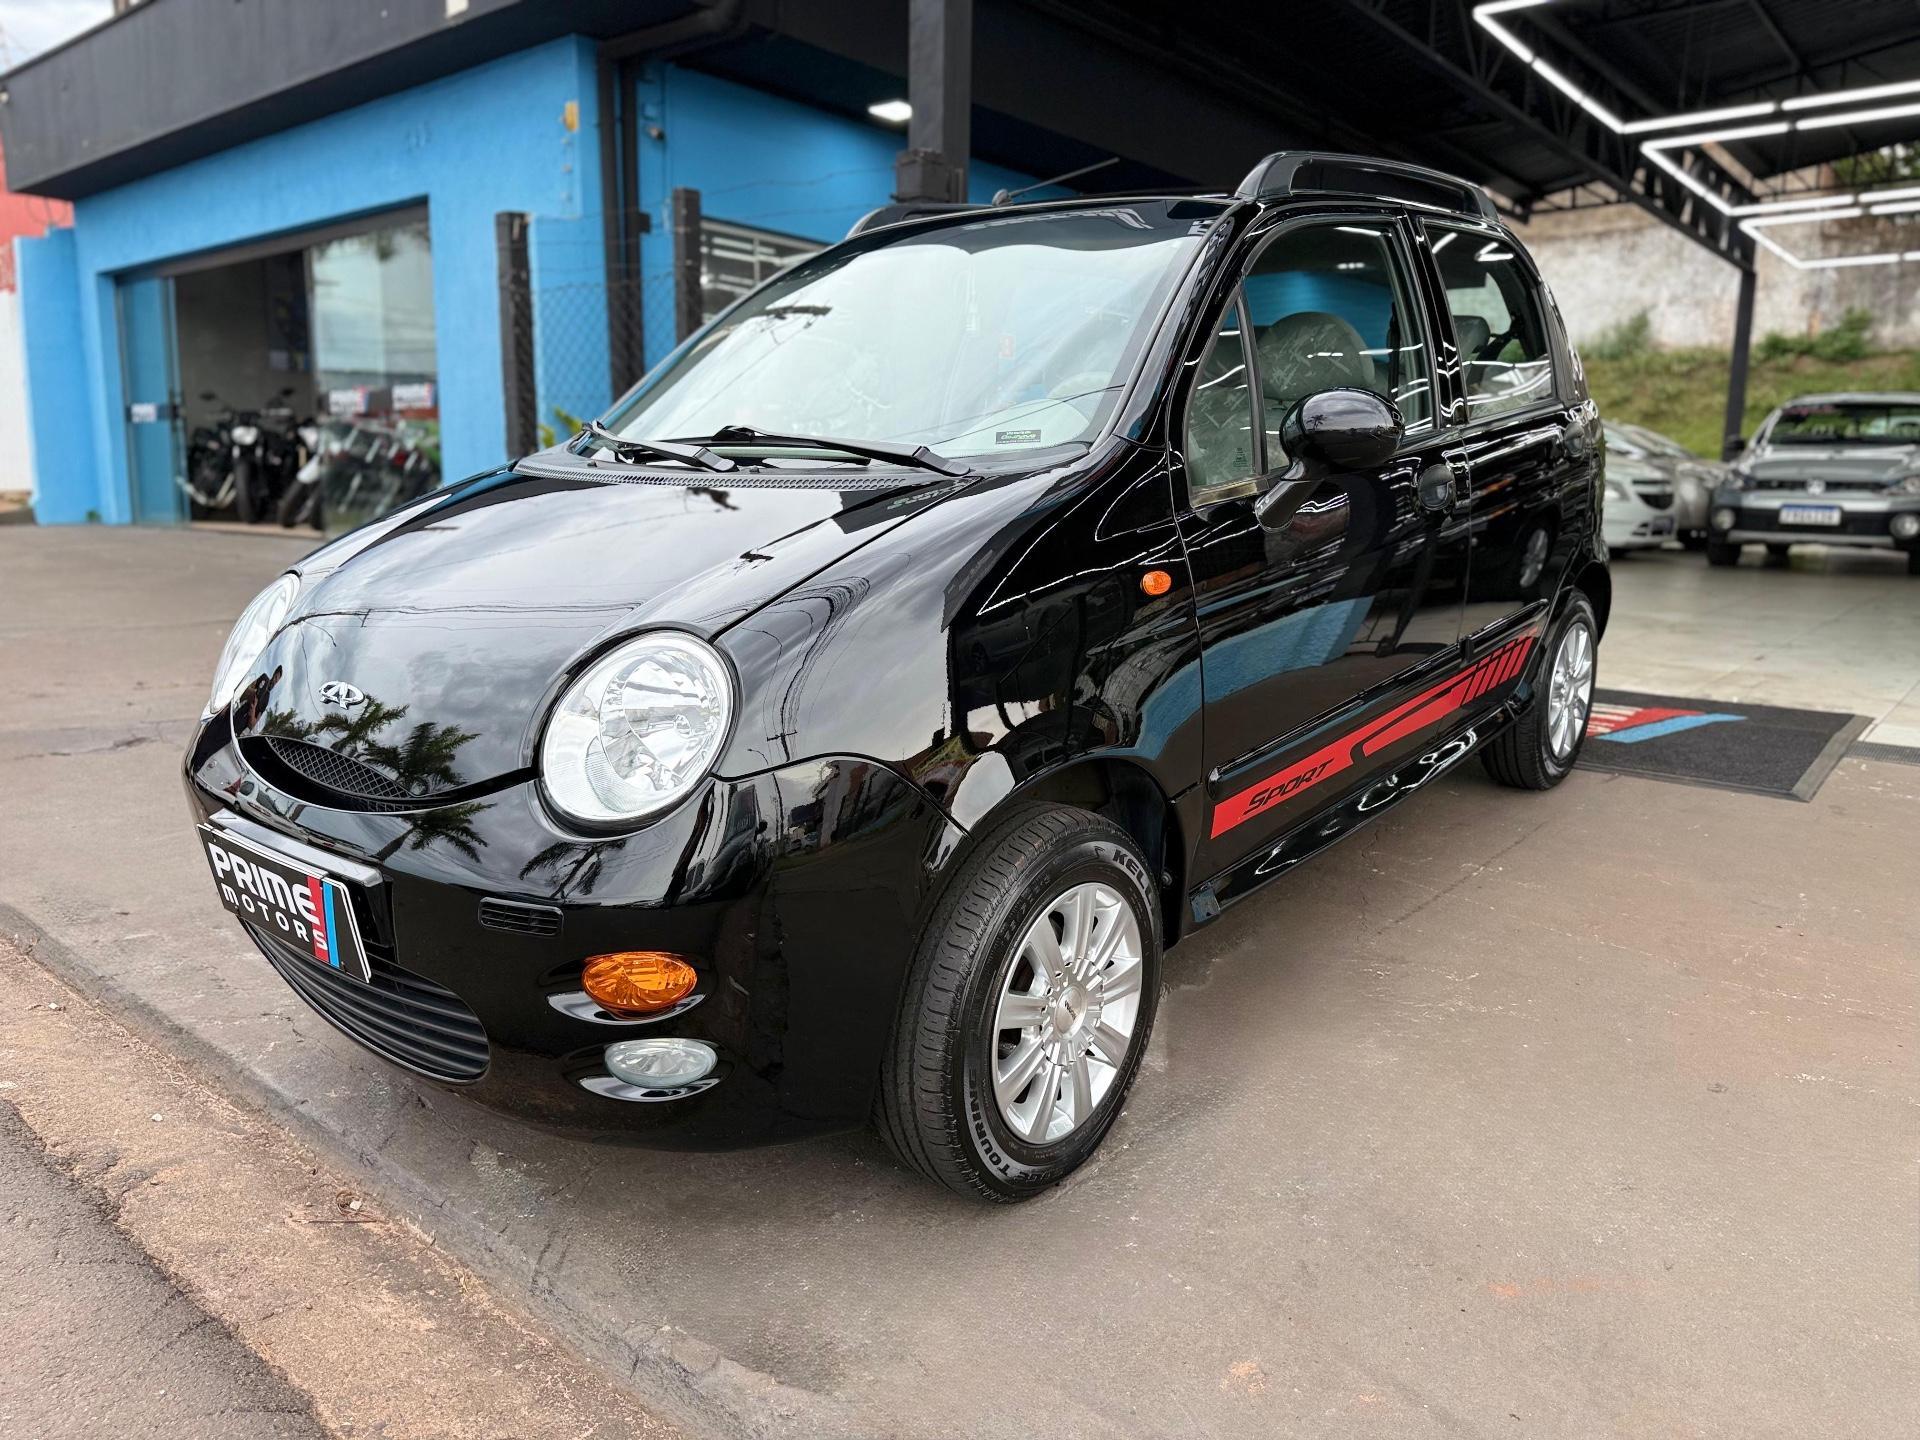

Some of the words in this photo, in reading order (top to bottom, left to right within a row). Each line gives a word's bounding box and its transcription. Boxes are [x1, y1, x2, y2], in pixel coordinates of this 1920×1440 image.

[1242, 758, 1335, 816] SPORT
[207, 841, 321, 926] PRIME
[1112, 849, 1153, 908] KELL
[220, 882, 329, 951] MOTORS
